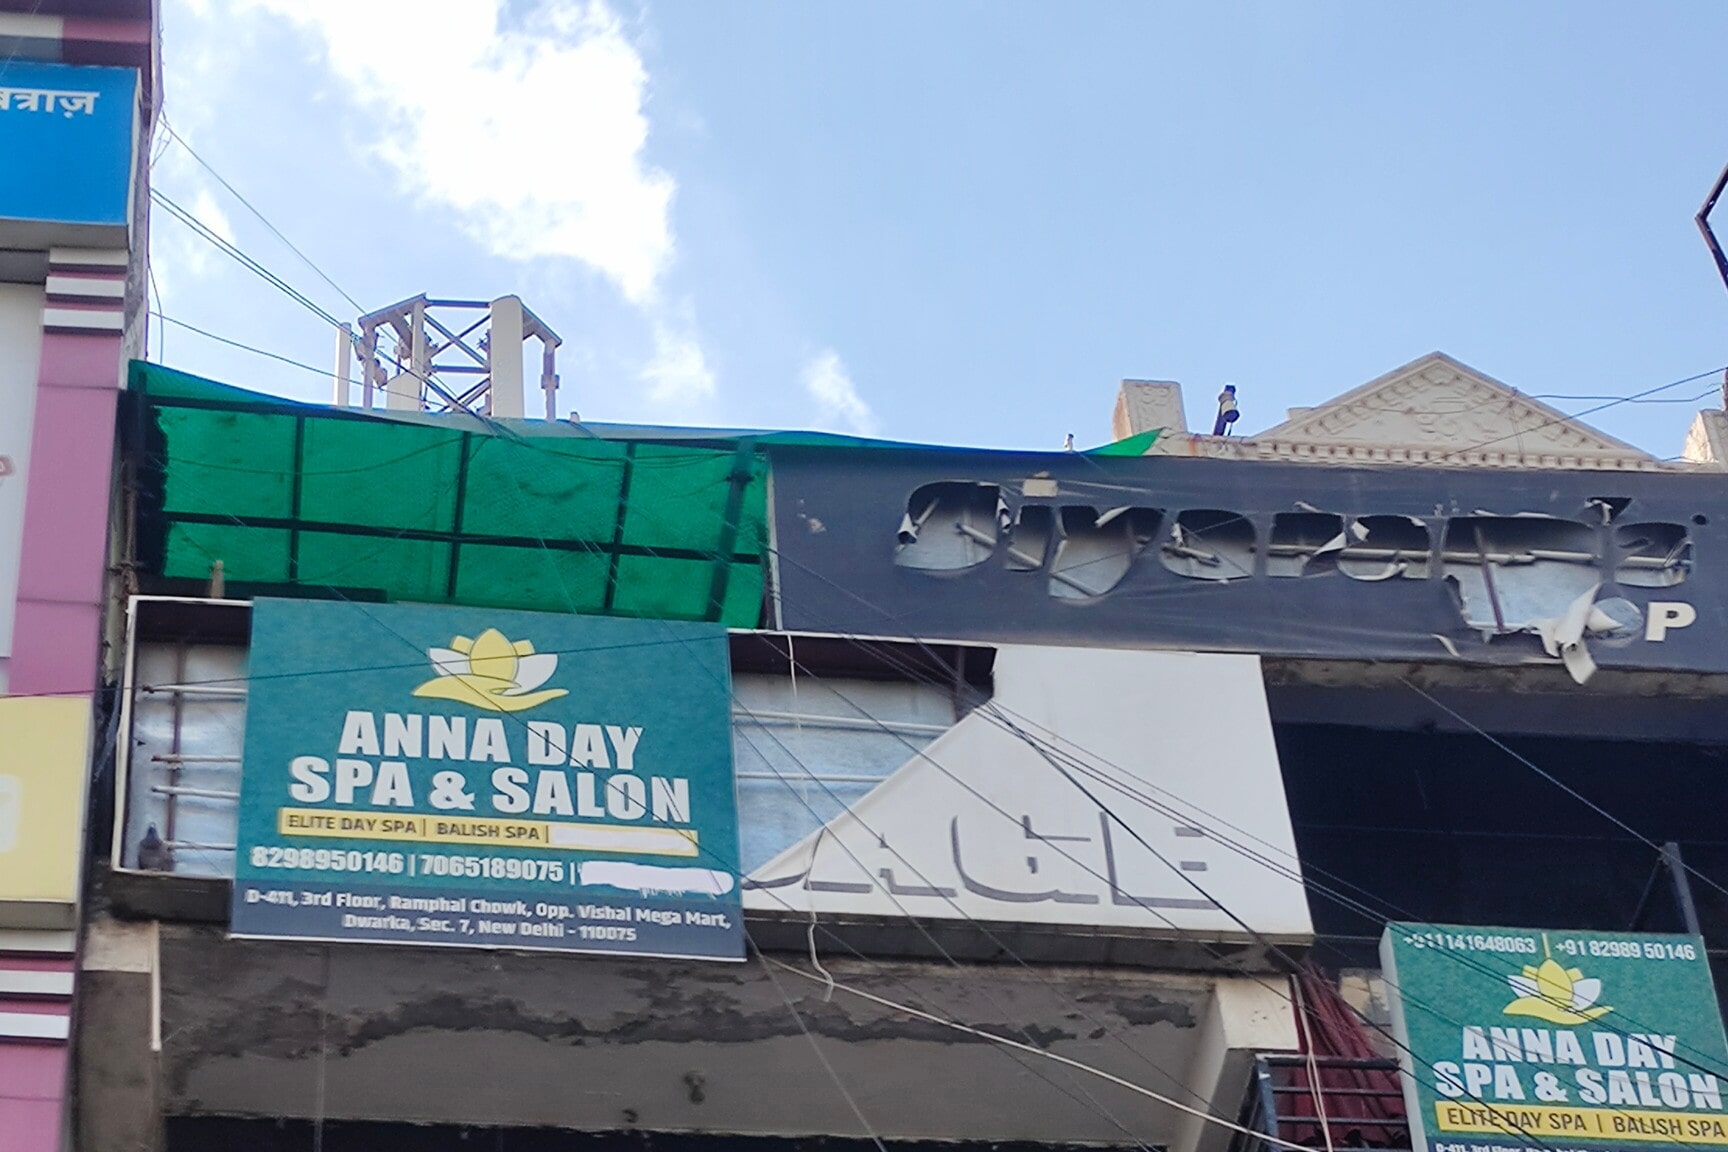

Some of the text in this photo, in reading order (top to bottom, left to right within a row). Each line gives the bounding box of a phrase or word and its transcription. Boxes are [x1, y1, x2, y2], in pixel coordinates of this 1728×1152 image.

[337, 710, 644, 770] ANNA DAY
[289, 756, 691, 824] SPA & SALON
[288, 814, 540, 841] ELITE DAY SPA BALISH SPA
[252, 846, 404, 874] 8298950146
[421, 854, 564, 882] 7065189075
[301, 891, 332, 907] 3rd
[336, 893, 387, 911] Floor,
[389, 896, 466, 914] Ramphal
[470, 899, 533, 918] Chowk,
[535, 903, 575, 920] Opp.
[579, 905, 632, 922] Vishal
[635, 908, 682, 926] Mega
[686, 911, 731, 930] Mart,
[342, 914, 416, 933] Dwarka,
[418, 917, 456, 932] Sec.
[460, 919, 476, 935] 7,
[478, 920, 516, 935] New
[520, 922, 565, 938] Delhi
[580, 925, 637, 942] 110075
[1555, 939, 1587, 956] +91
[1588, 940, 1642, 959] 82989
[1643, 943, 1697, 961] 50146
[1462, 1025, 1677, 1069] ANNA DAY
[1432, 1061, 1724, 1110] SPA & SALON
[1447, 1108, 1727, 1138] ELITE DAY SPA BALISH SPA
